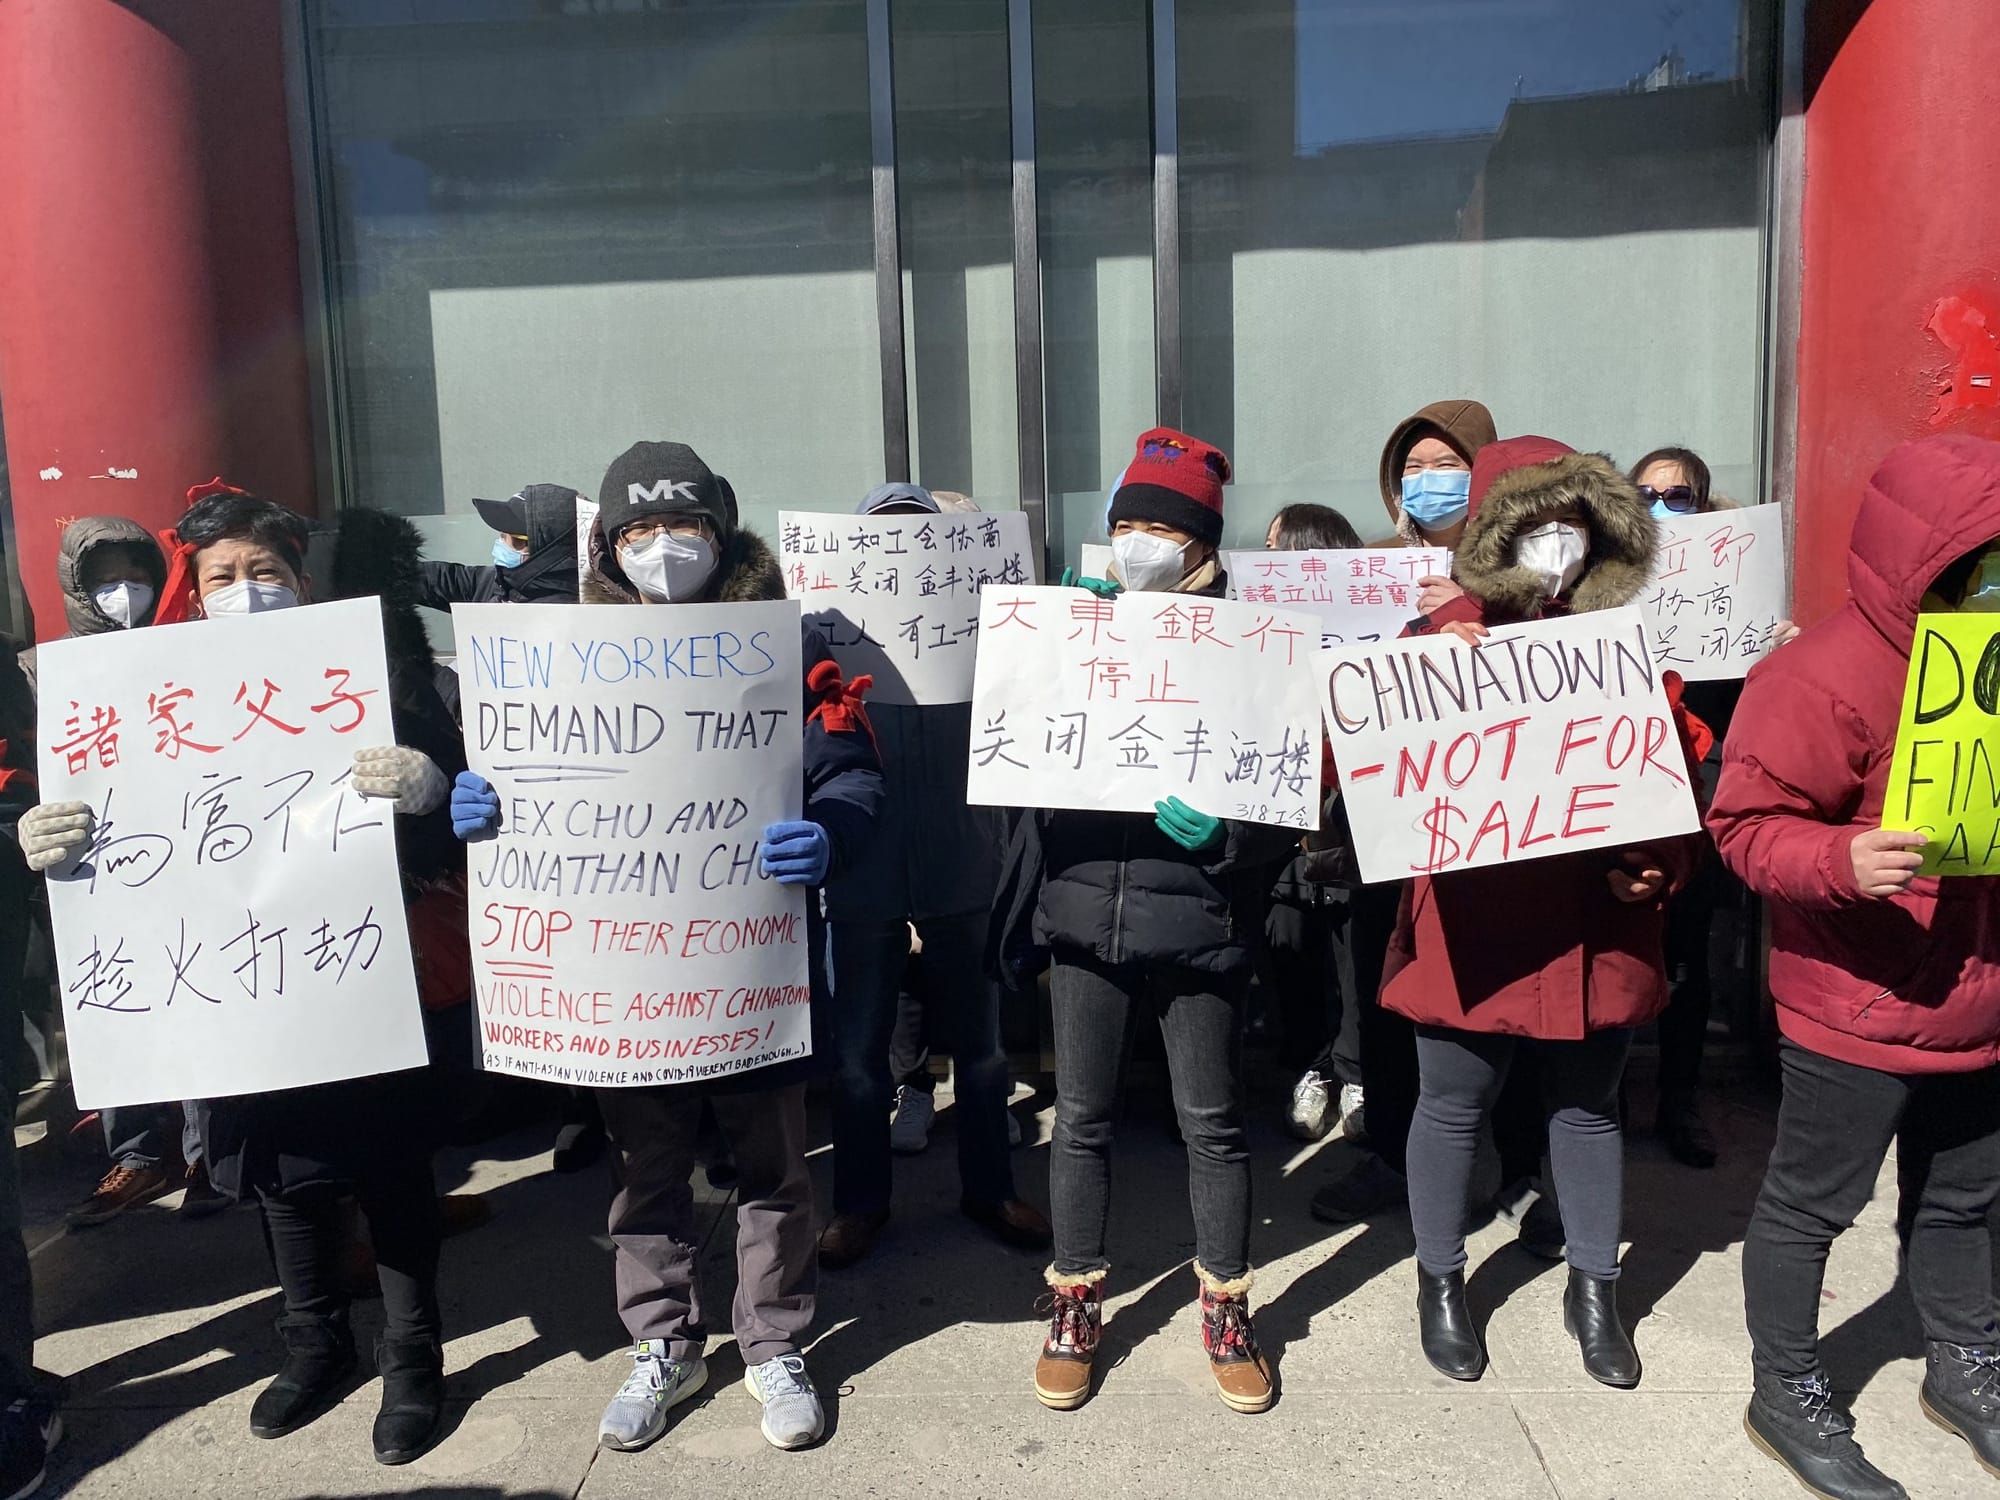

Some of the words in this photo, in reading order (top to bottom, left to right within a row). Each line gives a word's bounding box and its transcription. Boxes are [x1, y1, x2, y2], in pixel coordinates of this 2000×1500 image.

[628, 480, 699, 505] MK
[1254, 555, 1436, 581] 大東銀行
[1658, 525, 1756, 585] 立即
[1243, 581, 1420, 607] 諸立山諸寶
[988, 597, 1304, 665] 大東銀行
[472, 636, 552, 689] NEW
[572, 631, 774, 683] YORKERS
[1080, 656, 1199, 703] 停止
[1329, 624, 1654, 735] CHINATOWN
[51, 668, 378, 776] 諸家父子
[479, 702, 664, 754] DEMAND
[685, 709, 787, 752] THAT
[973, 709, 1312, 798] 关闭金丰酒楼
[1556, 714, 1685, 789] FOR
[566, 799, 652, 839] CHU
[666, 797, 749, 835] AND
[1410, 783, 1620, 871] $ALE
[478, 843, 680, 896] JONATHAN
[481, 903, 572, 957] STOP
[589, 918, 673, 956] THEIR
[681, 916, 801, 958] ECONOMIC
[480, 982, 612, 1025] VIOLENCE
[624, 989, 723, 1022] AGAINST
[485, 1021, 564, 1052] WORKERS
[570, 1035, 610, 1056] AND
[617, 1020, 775, 1059] BUSINESSES!
[505, 1055, 513, 1068] IF
[515, 1059, 571, 1080] ANTI-ASIAN
[575, 1067, 628, 1084] VIOLENCE
[632, 1071, 653, 1083] AND
[656, 1065, 694, 1081] COVID-19
